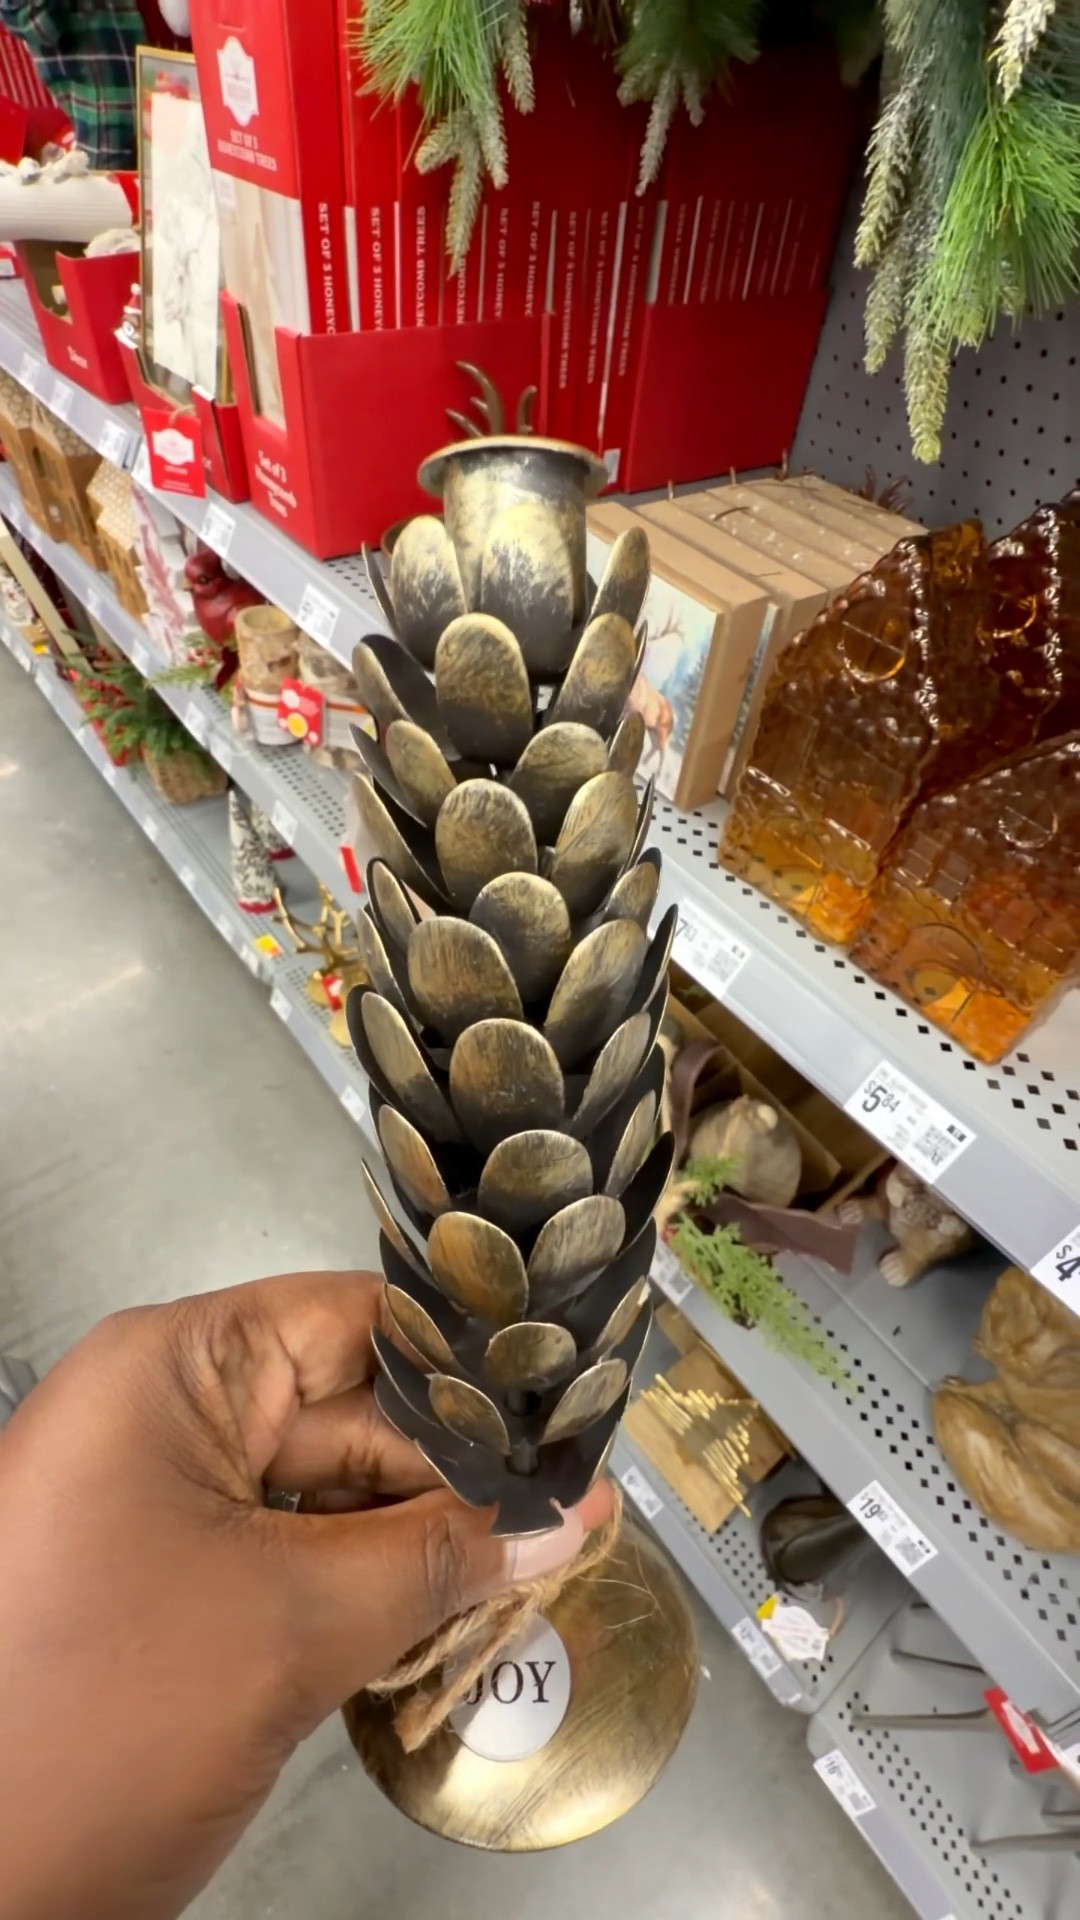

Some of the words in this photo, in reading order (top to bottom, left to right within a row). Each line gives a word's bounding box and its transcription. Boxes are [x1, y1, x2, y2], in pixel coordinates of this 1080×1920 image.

[319, 202, 329, 234] SET
[371, 207, 381, 238] SET
[499, 207, 509, 236] SET
[531, 201, 540, 229] SET
[568, 211, 577, 237] SET
[416, 205, 426, 256] TREES
[529, 231, 538, 252] OF
[321, 238, 331, 259] OF
[372, 241, 381, 261] OF
[498, 239, 507, 258] OF
[567, 241, 576, 259] OF
[323, 263, 332, 271] 3
[373, 265, 382, 274] 3
[463, 1660, 557, 1706] JOY
